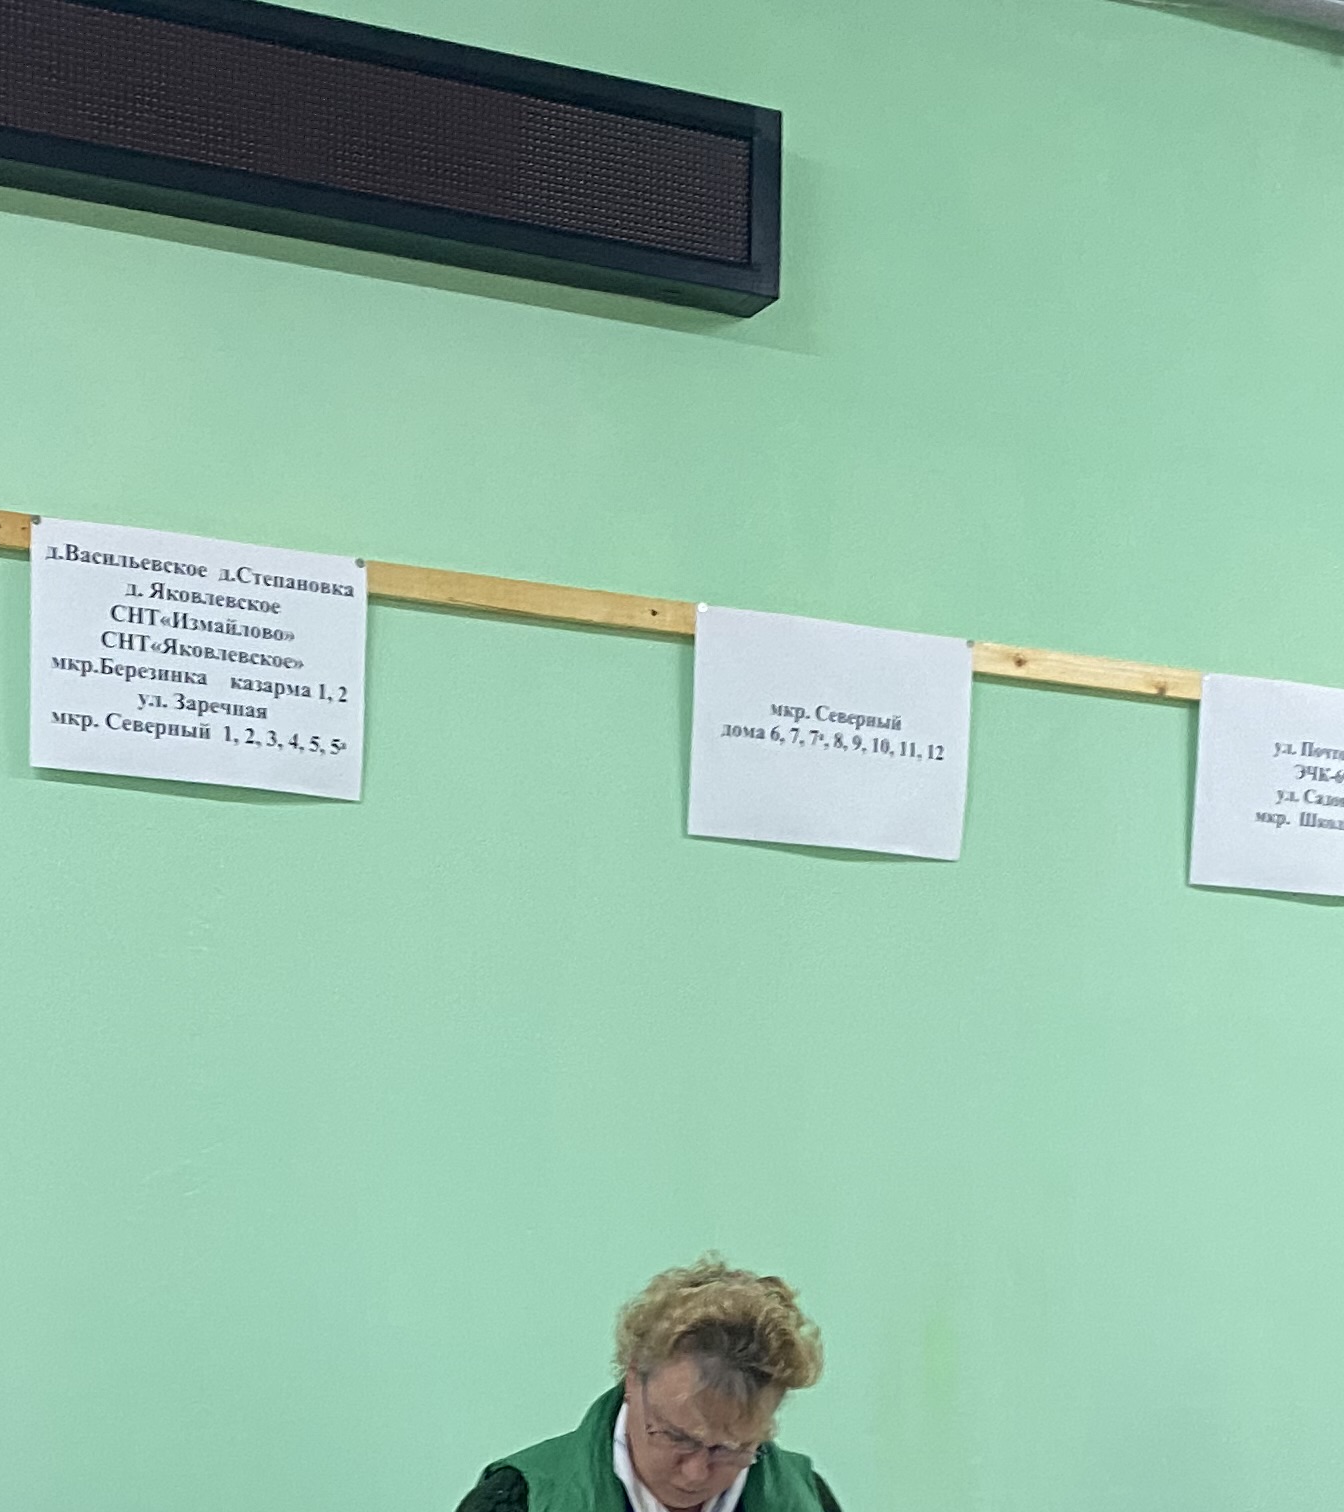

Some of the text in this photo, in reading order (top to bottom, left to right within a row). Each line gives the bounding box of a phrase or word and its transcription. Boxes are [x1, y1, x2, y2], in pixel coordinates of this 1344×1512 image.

[45, 543, 354, 598] д.Васильевское д.Степановка
[125, 582, 282, 614] д. Яковлевское
[110, 604, 295, 642] СНТ«Измайлово»
[101, 631, 304, 670] СНТ«Яковлевское»
[51, 654, 348, 703] мкр.Березинка казарма 1, 2
[137, 692, 268, 720] ул. Заречная
[770, 703, 902, 730] мкр. Северный
[51, 709, 99, 731] мкр.
[106, 712, 211, 740] Северный
[223, 725, 239, 744] 1,
[245, 728, 261, 747] 2,
[266, 731, 282, 750] 3,
[309, 735, 325, 755] 5,
[720, 723, 765, 740] дома
[770, 725, 785, 743] 6,
[790, 727, 805, 745] 7,
[833, 732, 848, 751] 8,
[852, 734, 867, 752] 9,
[872, 737, 894, 756] 10,
[899, 741, 922, 760] 11,
[927, 743, 945, 761] 12
[1273, 741, 1296, 757] ул.
[1275, 788, 1299, 804] ул.
[1255, 811, 1291, 828] мкр.
